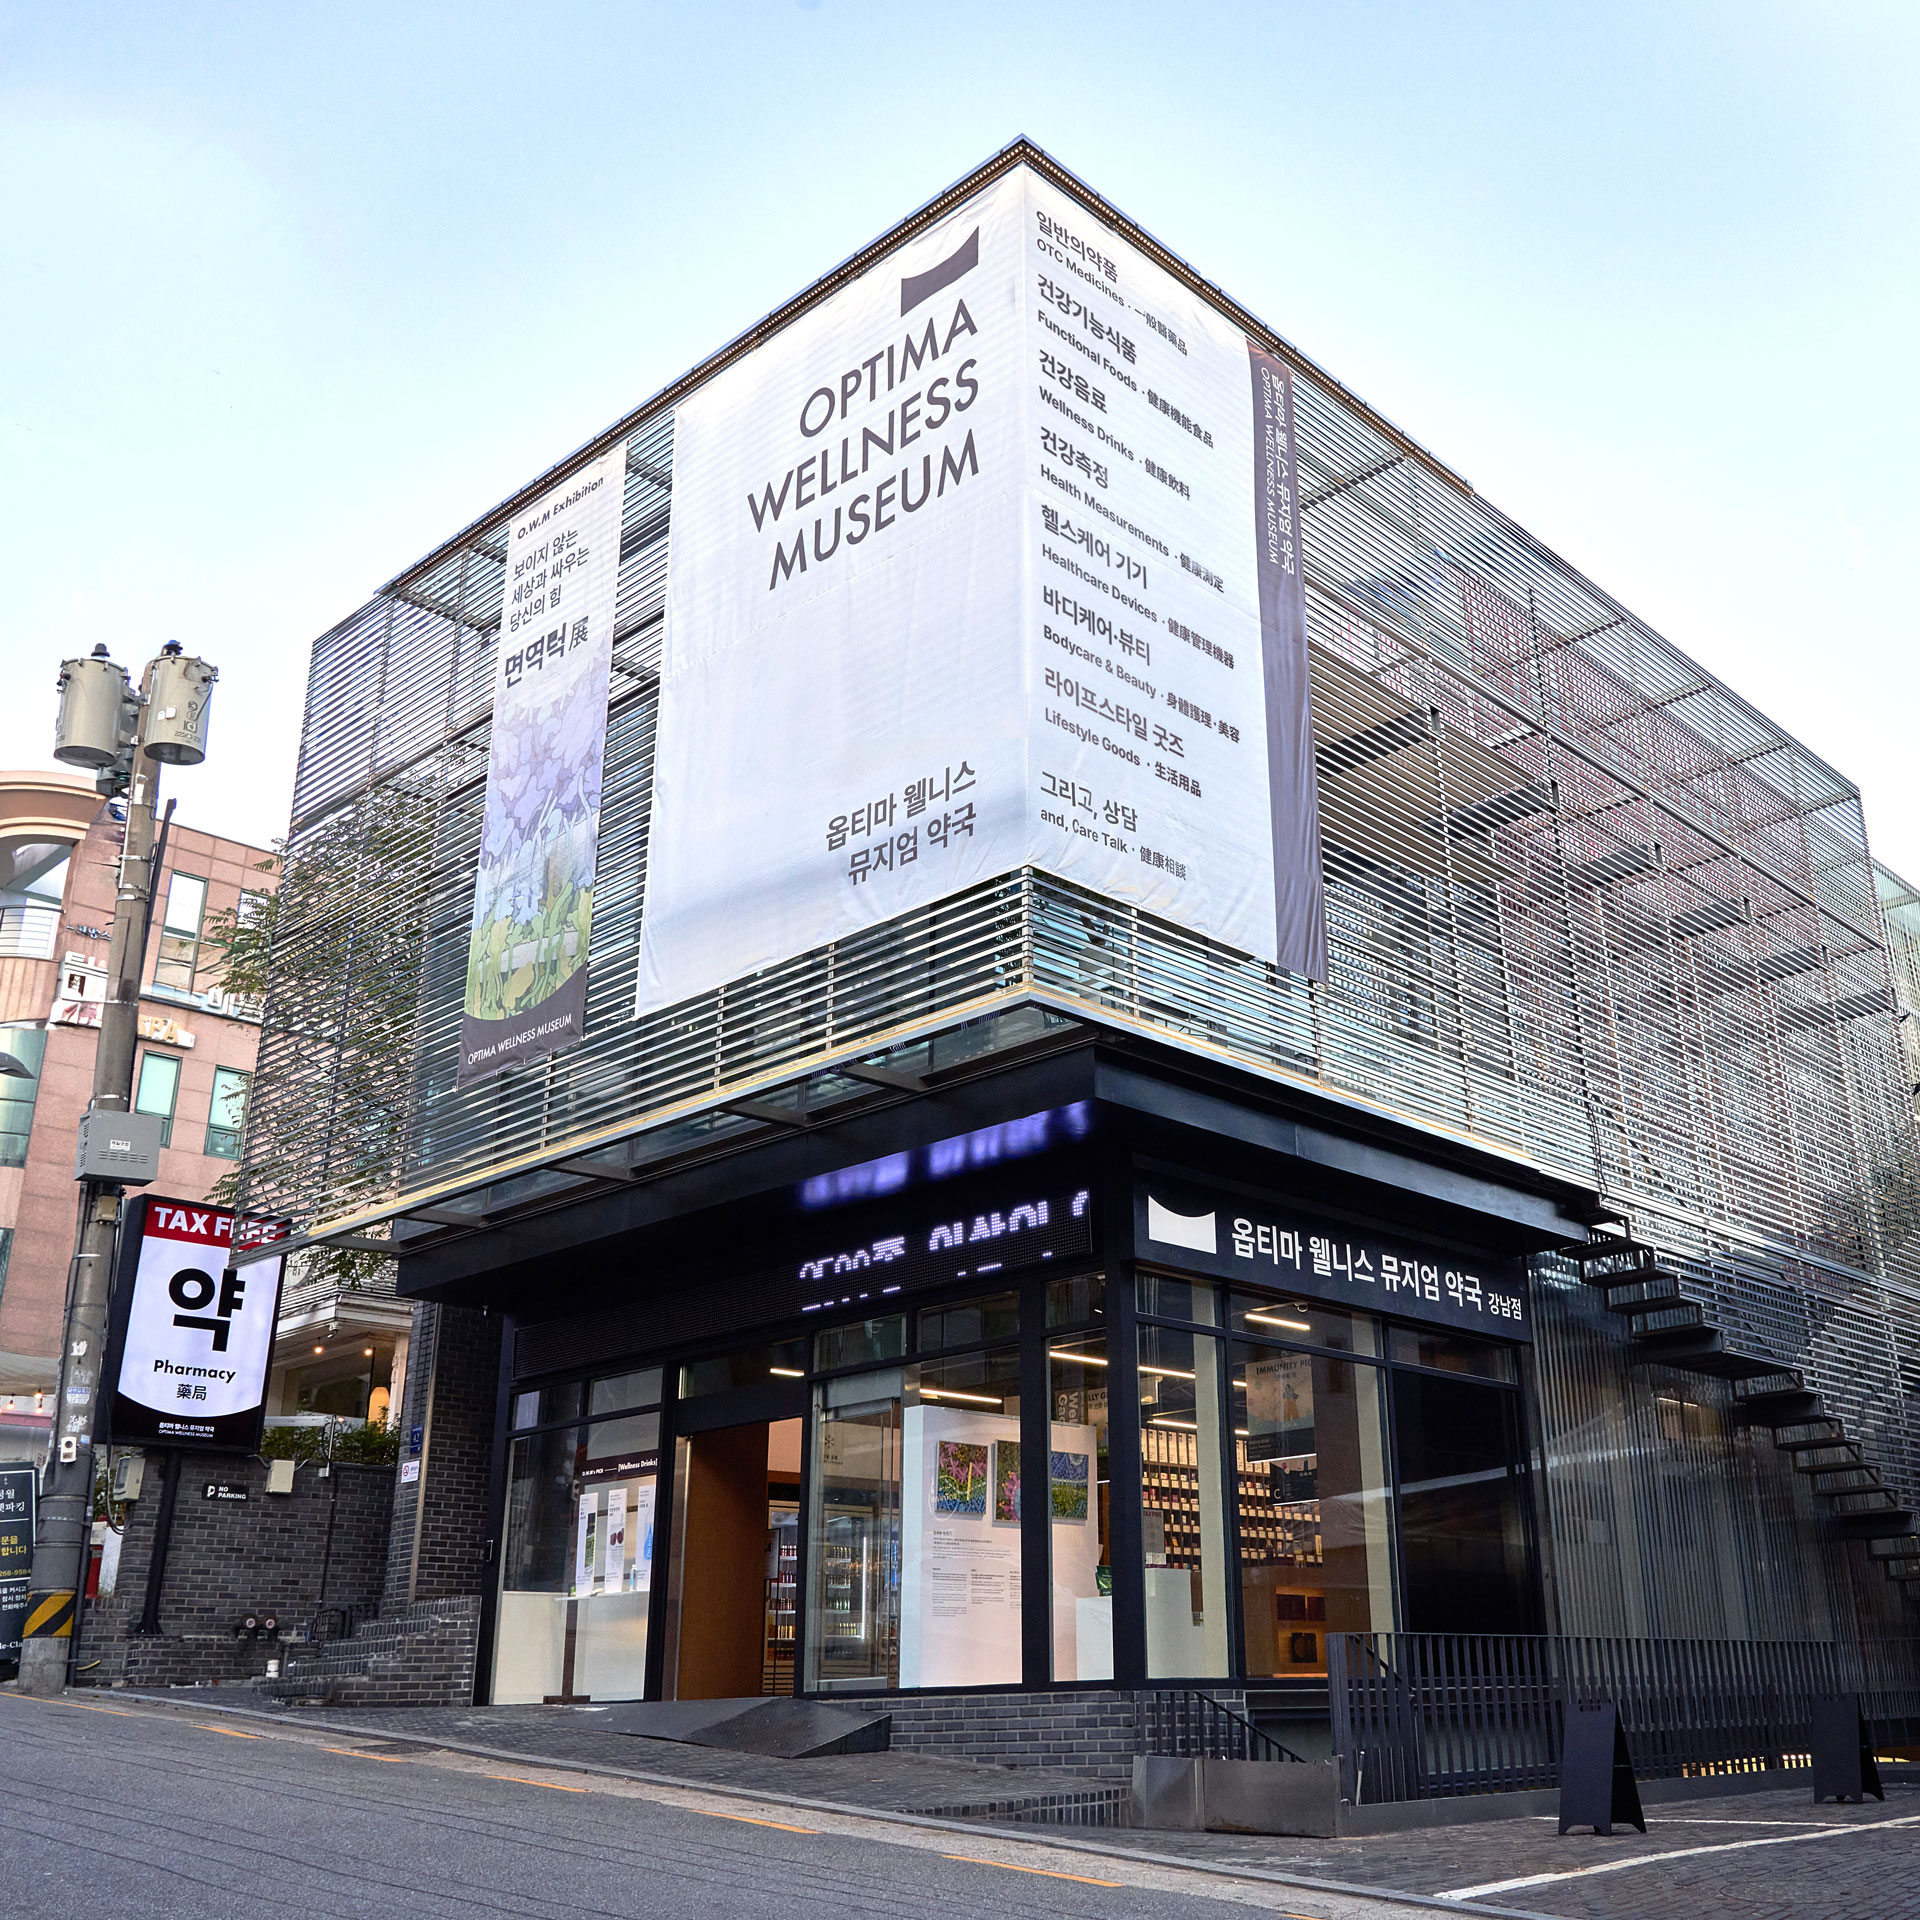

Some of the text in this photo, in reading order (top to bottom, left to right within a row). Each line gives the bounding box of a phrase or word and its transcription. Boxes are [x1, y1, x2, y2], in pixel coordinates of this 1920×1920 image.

[1036, 210, 1118, 284] 일반의약품
[1036, 237, 1063, 264] OTC
[1066, 256, 1125, 307] Medicines
[1038, 273, 1137, 364] 건강기능식품
[800, 298, 979, 438] OPTIMA
[1038, 311, 1215, 449] Functional Foods 健康機能食品
[1039, 349, 1108, 414] 건강음료
[1272, 374, 1287, 428] 옵티마
[747, 358, 980, 533] WELLNESS
[1039, 385, 1191, 502] Wellness Drinks 健康飲料
[1040, 427, 1109, 490] 건강측정
[1261, 367, 1279, 564] OPTIMA WELLNESS MUSEUM
[517, 476, 604, 540] O.W.M Exhibition
[769, 428, 979, 591] MUSEUM
[1040, 464, 1082, 500] Health
[1084, 495, 1170, 557] Measurements
[1277, 482, 1293, 538] 뮤지엄
[511, 546, 590, 605] 세상과 싸우는
[513, 528, 579, 582] 보이지 않는
[1041, 503, 1148, 589] 헬스케어 기기
[1042, 543, 1110, 594] Healthcare
[1112, 583, 1158, 623] Devices
[1280, 539, 1295, 575] 약국
[510, 584, 562, 632] 당신의 힘
[1044, 624, 1103, 668] Bodycare
[1105, 659, 1114, 675] &
[1116, 664, 1157, 699] Beauty
[1045, 667, 1185, 759] 라이프스타일 굿즈
[1045, 707, 1202, 798] Lifestyle Goods 生活用品
[826, 761, 976, 852] 옵티마 웰니스
[1040, 771, 1138, 833] 그리고, 상담
[848, 802, 976, 886] 뮤지엄 약국
[1040, 807, 1187, 881] and, Care Talk 健康相談
[468, 1013, 572, 1065] OPTIMA WELLNESS MUSEUM
[154, 1206, 208, 1236] TAX
[1232, 1218, 1522, 1321] 옵티마 웰니스 뮤지엄 약국 강남점
[168, 1268, 246, 1352] 약
[153, 1359, 236, 1383] Pharmacy
[176, 1384, 207, 1401] 藥局
[1256, 1360, 1298, 1375] IMMUNITY
[218, 1492, 246, 1500] PARKING
